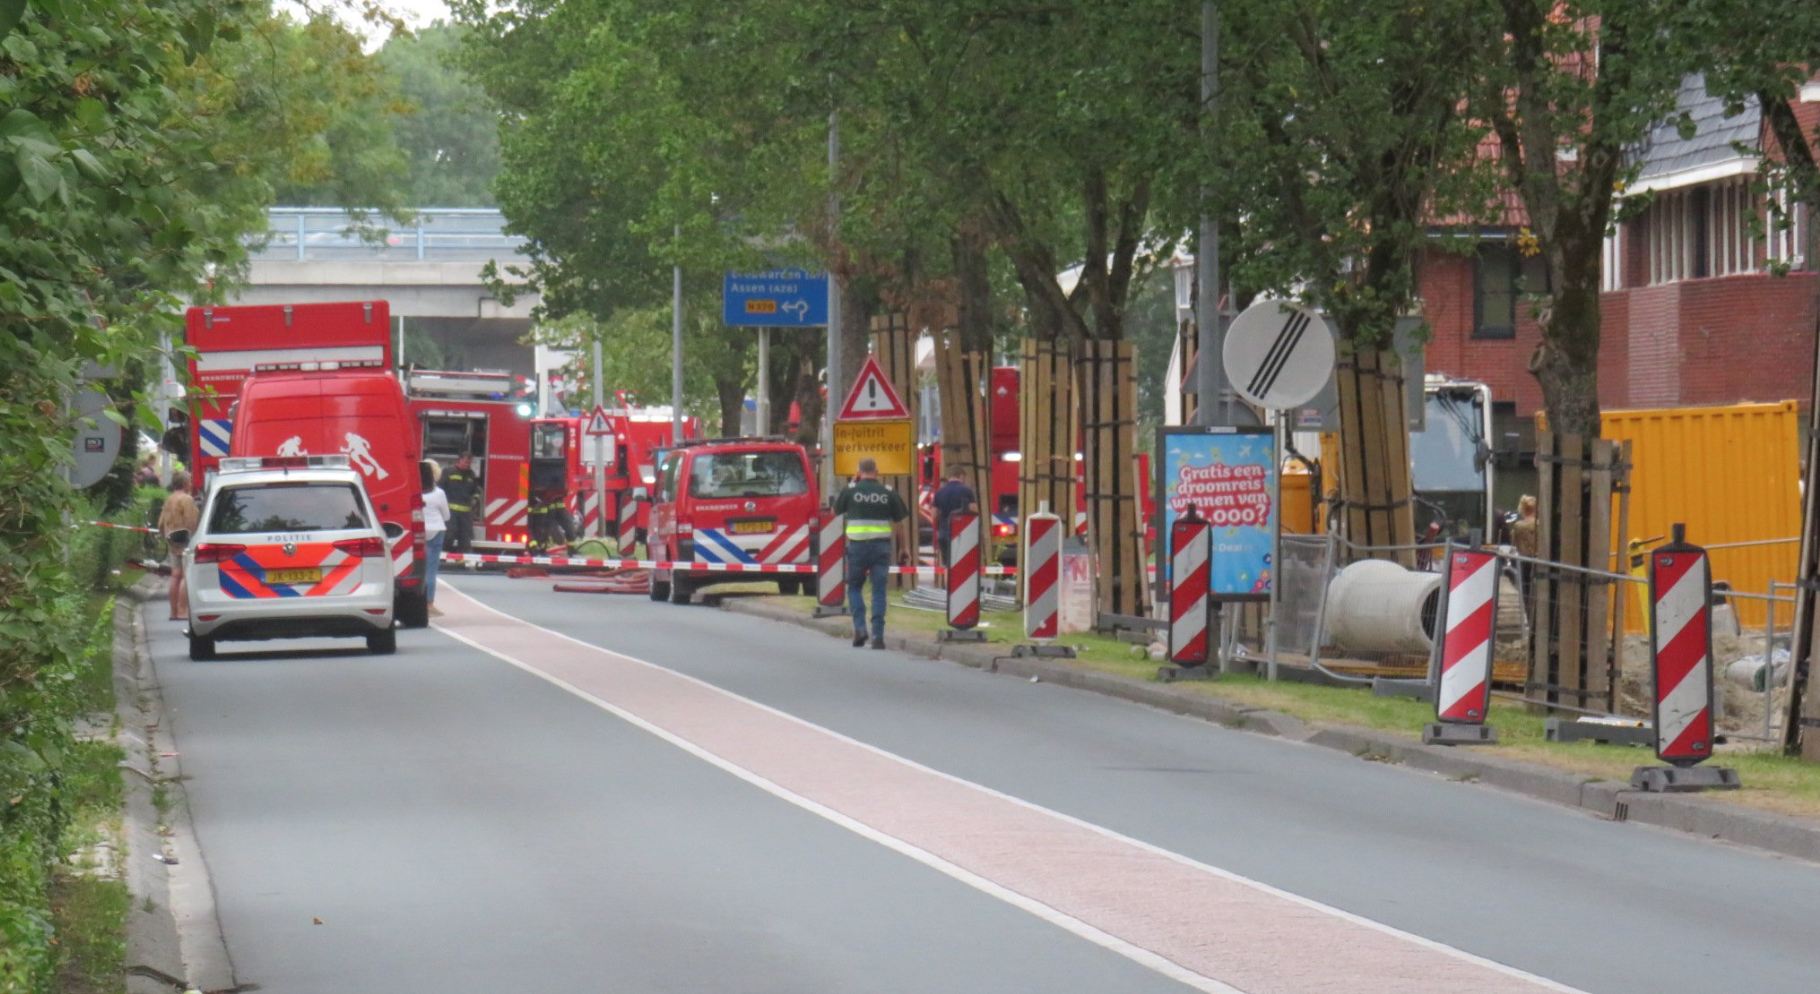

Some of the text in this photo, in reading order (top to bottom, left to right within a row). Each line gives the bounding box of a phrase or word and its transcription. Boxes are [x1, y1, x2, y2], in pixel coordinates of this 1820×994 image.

[731, 283, 798, 294] Assen (A28)
[835, 442, 907, 453] werkverkeer
[1180, 463, 1262, 482] Gratis een
[1178, 477, 1261, 495] droomreis
[854, 492, 888, 504] OvDG
[1172, 493, 1268, 508] winnen van
[267, 534, 312, 542] POLITIE
[273, 570, 315, 581] JK-133-Z
